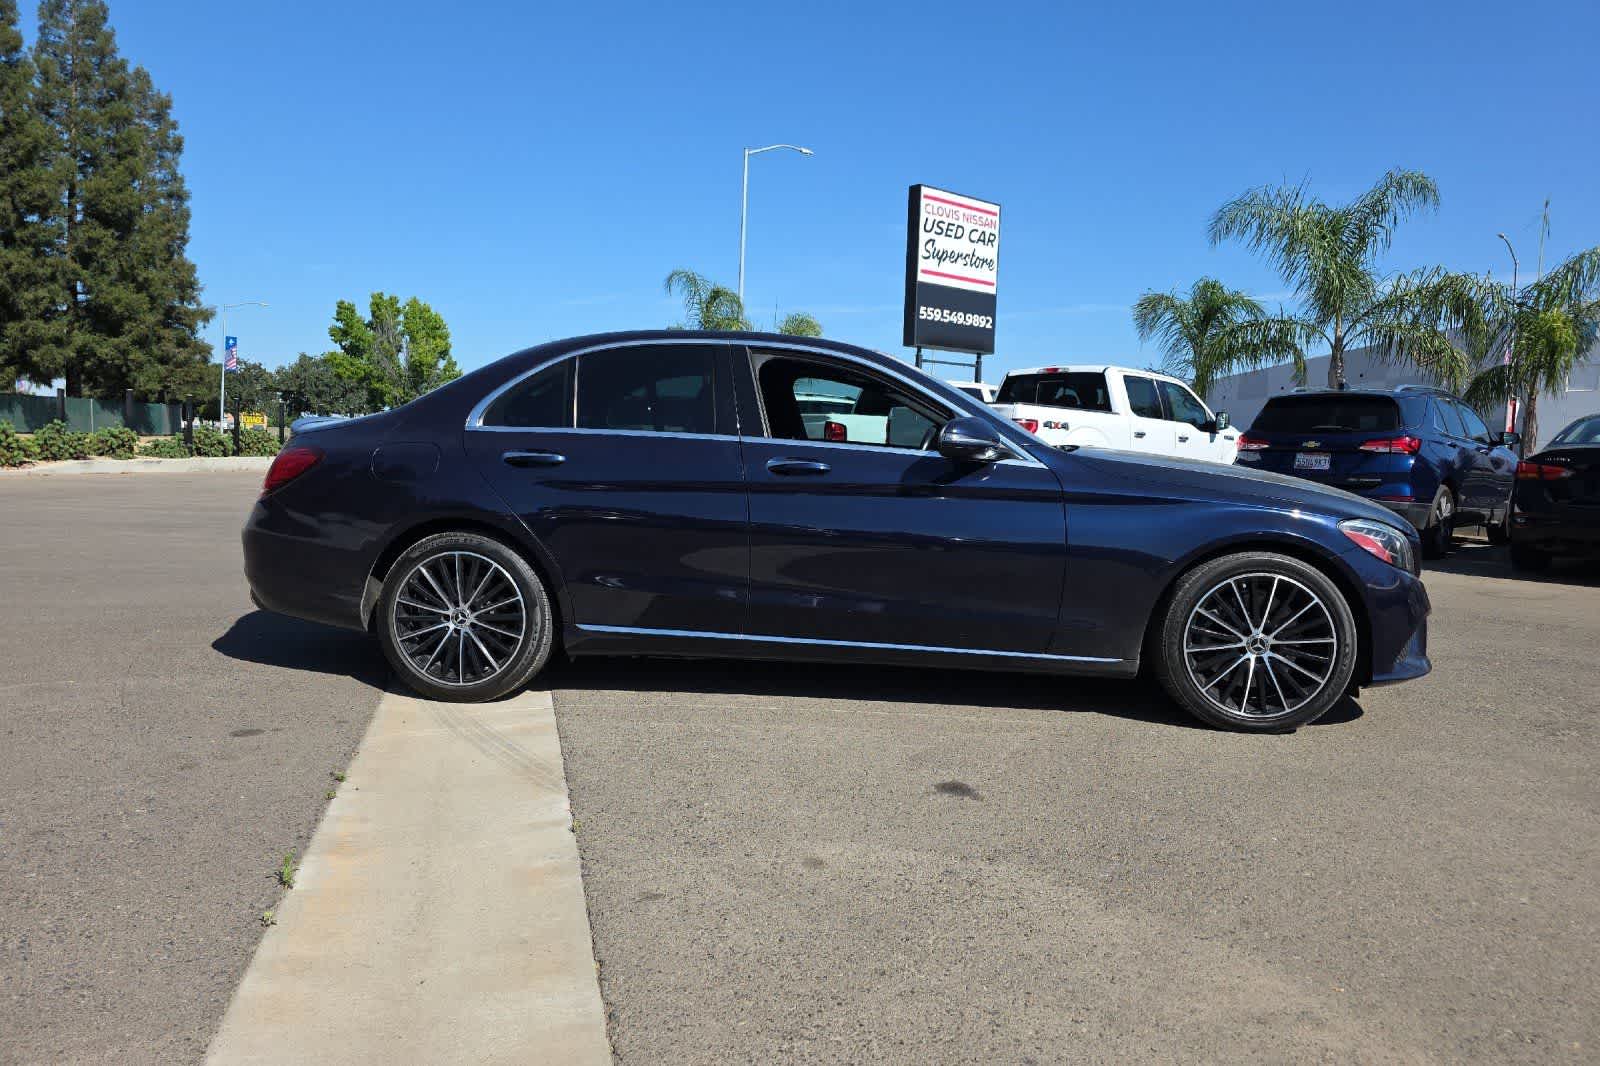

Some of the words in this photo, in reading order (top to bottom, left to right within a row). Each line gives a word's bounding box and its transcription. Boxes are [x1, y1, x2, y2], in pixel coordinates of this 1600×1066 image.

[924, 203, 960, 222] CLOVIS
[963, 212, 997, 230] NISSAN
[923, 217, 965, 240] USED
[968, 228, 997, 248] CAR
[921, 238, 995, 272] Superstore
[919, 306, 993, 329] 559.549.9892
